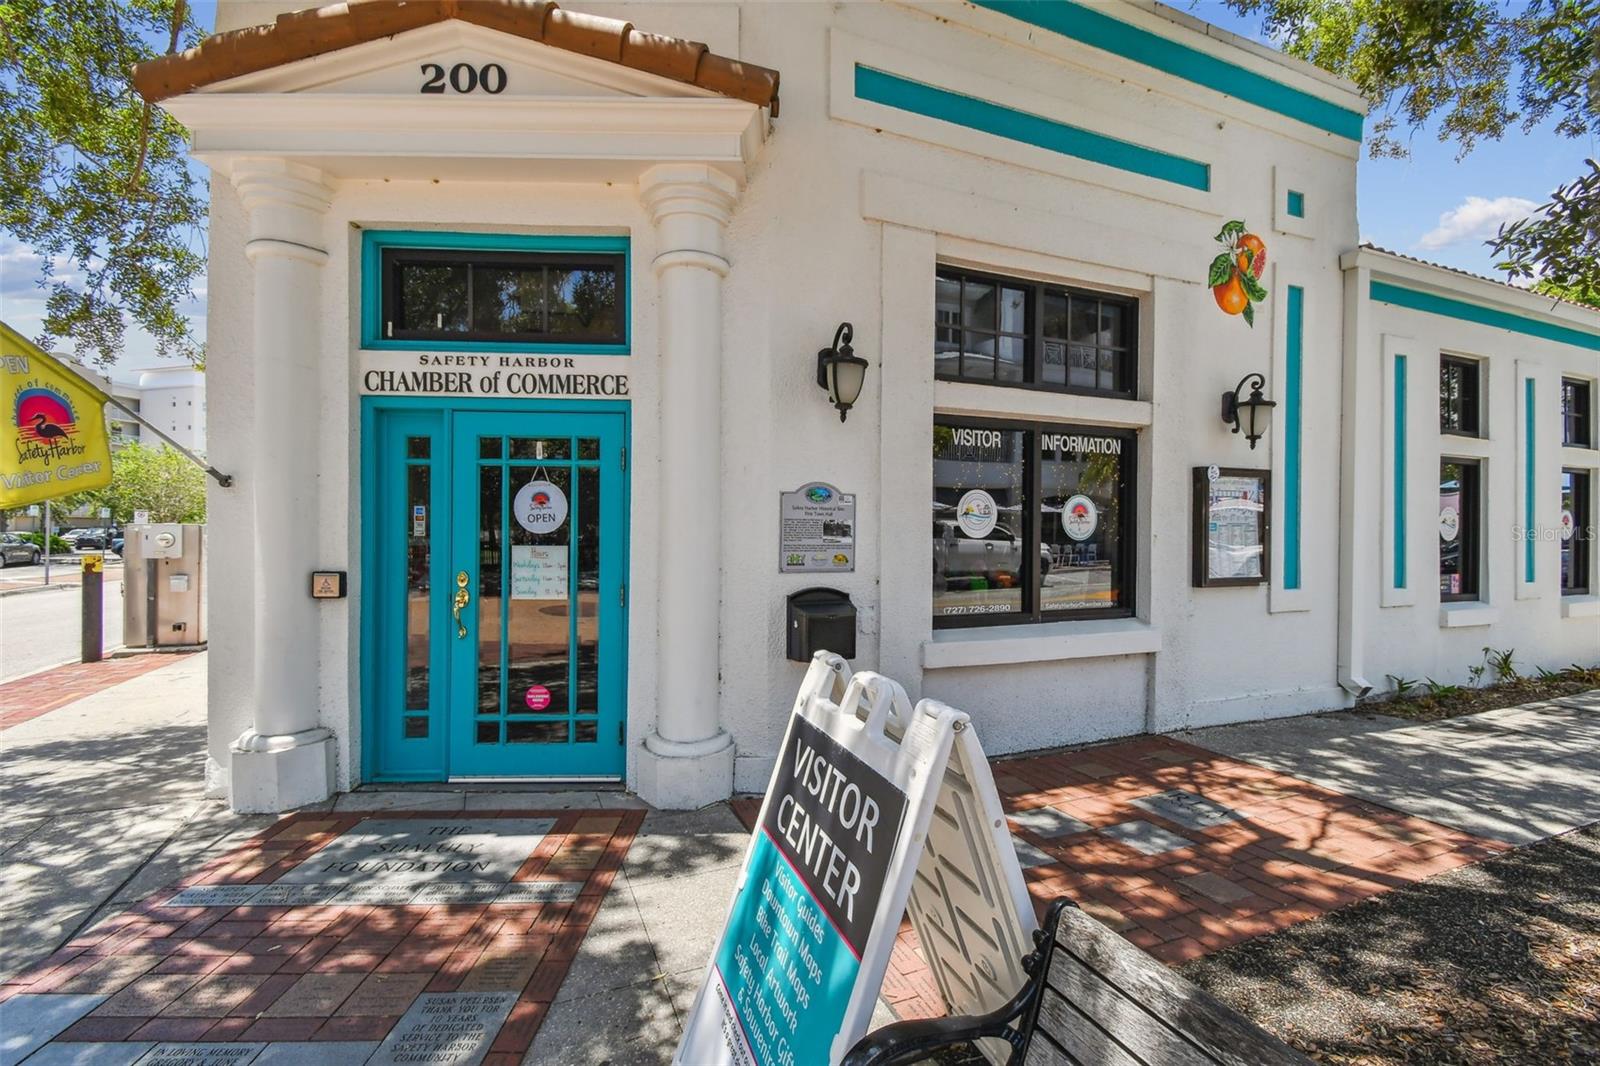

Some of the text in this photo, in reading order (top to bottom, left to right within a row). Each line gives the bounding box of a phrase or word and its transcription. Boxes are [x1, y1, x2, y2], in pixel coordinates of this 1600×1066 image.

[420, 63, 508, 94] 200
[420, 354, 575, 369] SAFETY HARBOR
[364, 370, 629, 396] CHAMBER of COMMERCE
[15, 437, 86, 466] Safety Harbor
[952, 428, 1121, 455] VISITOR INFORMATION
[527, 513, 556, 523] OPEN
[944, 604, 1011, 615] (727) 726-2890
[794, 738, 880, 854] VISITOR
[428, 825, 473, 836] THE
[322, 861, 492, 873] FOUNDATION
[777, 793, 861, 922] CENTER
[776, 860, 825, 944] Visitor Guides
[762, 878, 822, 985] Downtown Maps
[756, 906, 810, 1010] Bike Trail Maps
[735, 944, 755, 995] Safety
[754, 983, 779, 1041] Harbor
[750, 933, 797, 1036] Local Artwork
[421, 1005, 500, 1014] THANK YOU FOR
[400, 1033, 484, 1042] SERVICE TO THE
[412, 1023, 484, 1032] OF DEDICATED
[738, 987, 776, 1066] & Souvenir
[393, 1054, 461, 1063] COMMUNITY
